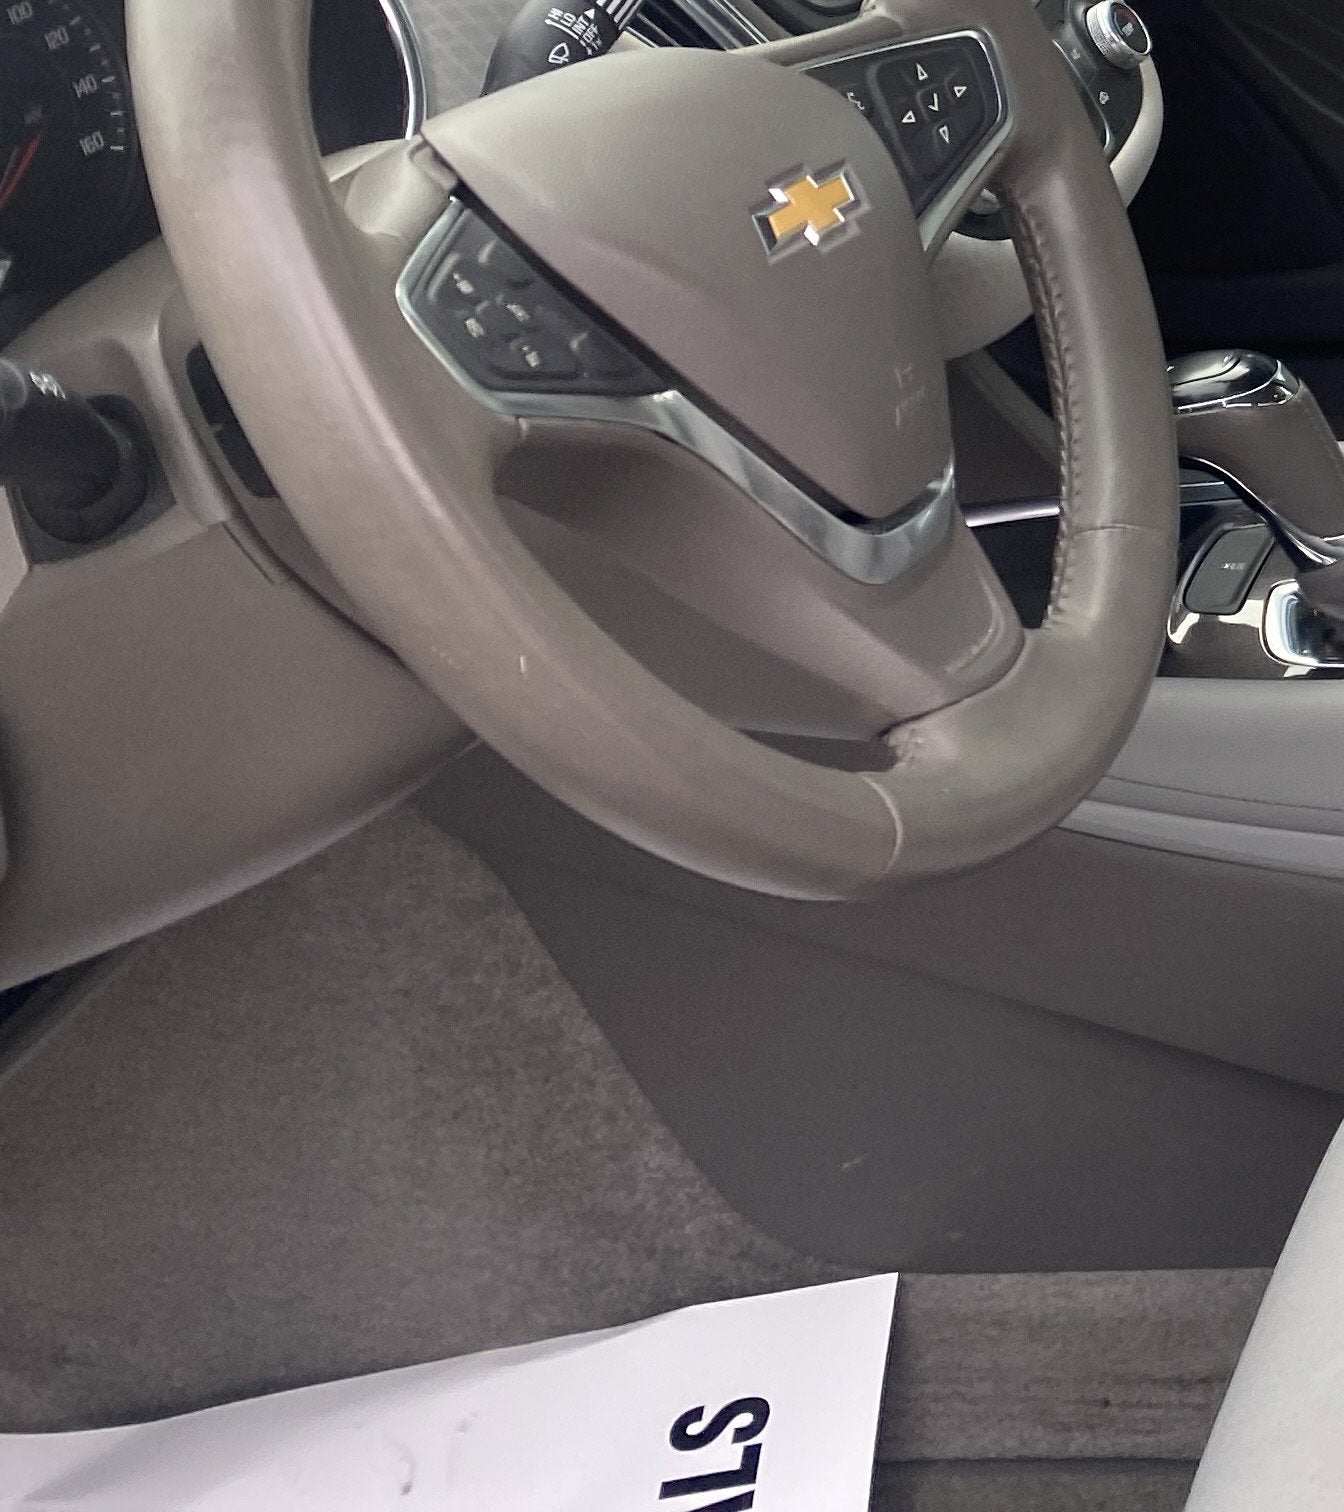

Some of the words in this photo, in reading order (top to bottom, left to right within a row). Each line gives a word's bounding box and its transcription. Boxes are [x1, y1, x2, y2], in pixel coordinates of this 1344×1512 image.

[6, 0, 33, 25] 100
[559, 12, 577, 28] LO
[571, 14, 590, 36] INT
[44, 25, 69, 50] 120
[582, 23, 599, 44] OFF
[72, 73, 98, 99] 140
[79, 130, 105, 156] 160
